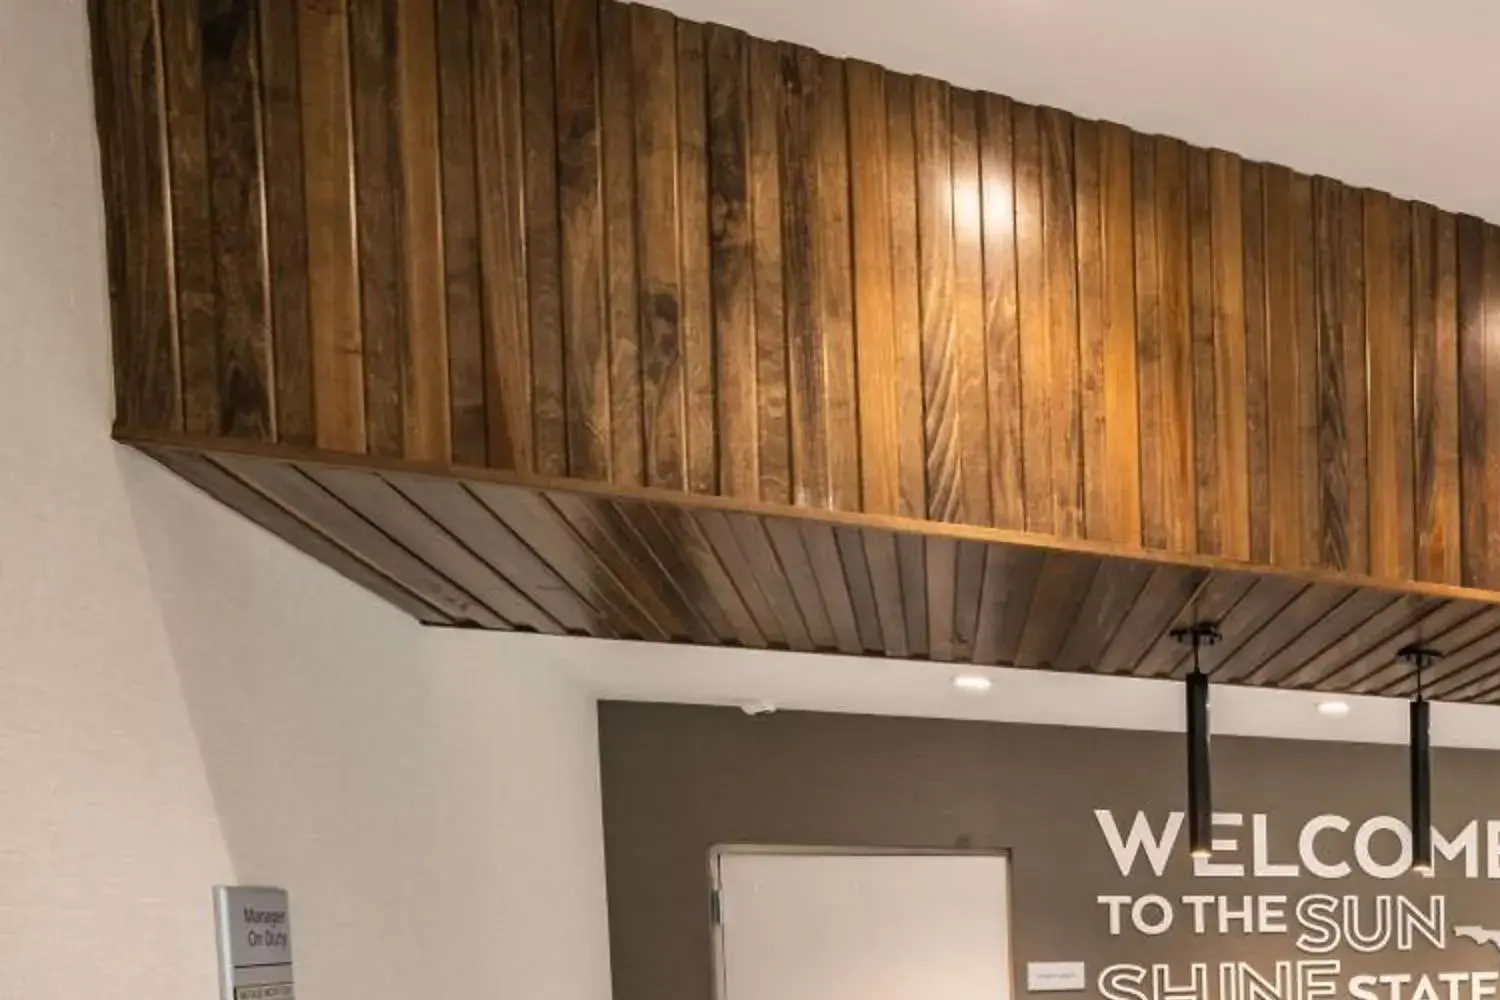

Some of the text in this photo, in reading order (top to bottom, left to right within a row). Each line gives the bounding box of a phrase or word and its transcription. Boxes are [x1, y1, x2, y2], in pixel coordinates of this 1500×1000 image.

[1097, 893, 1446, 953] TO THE SUN
